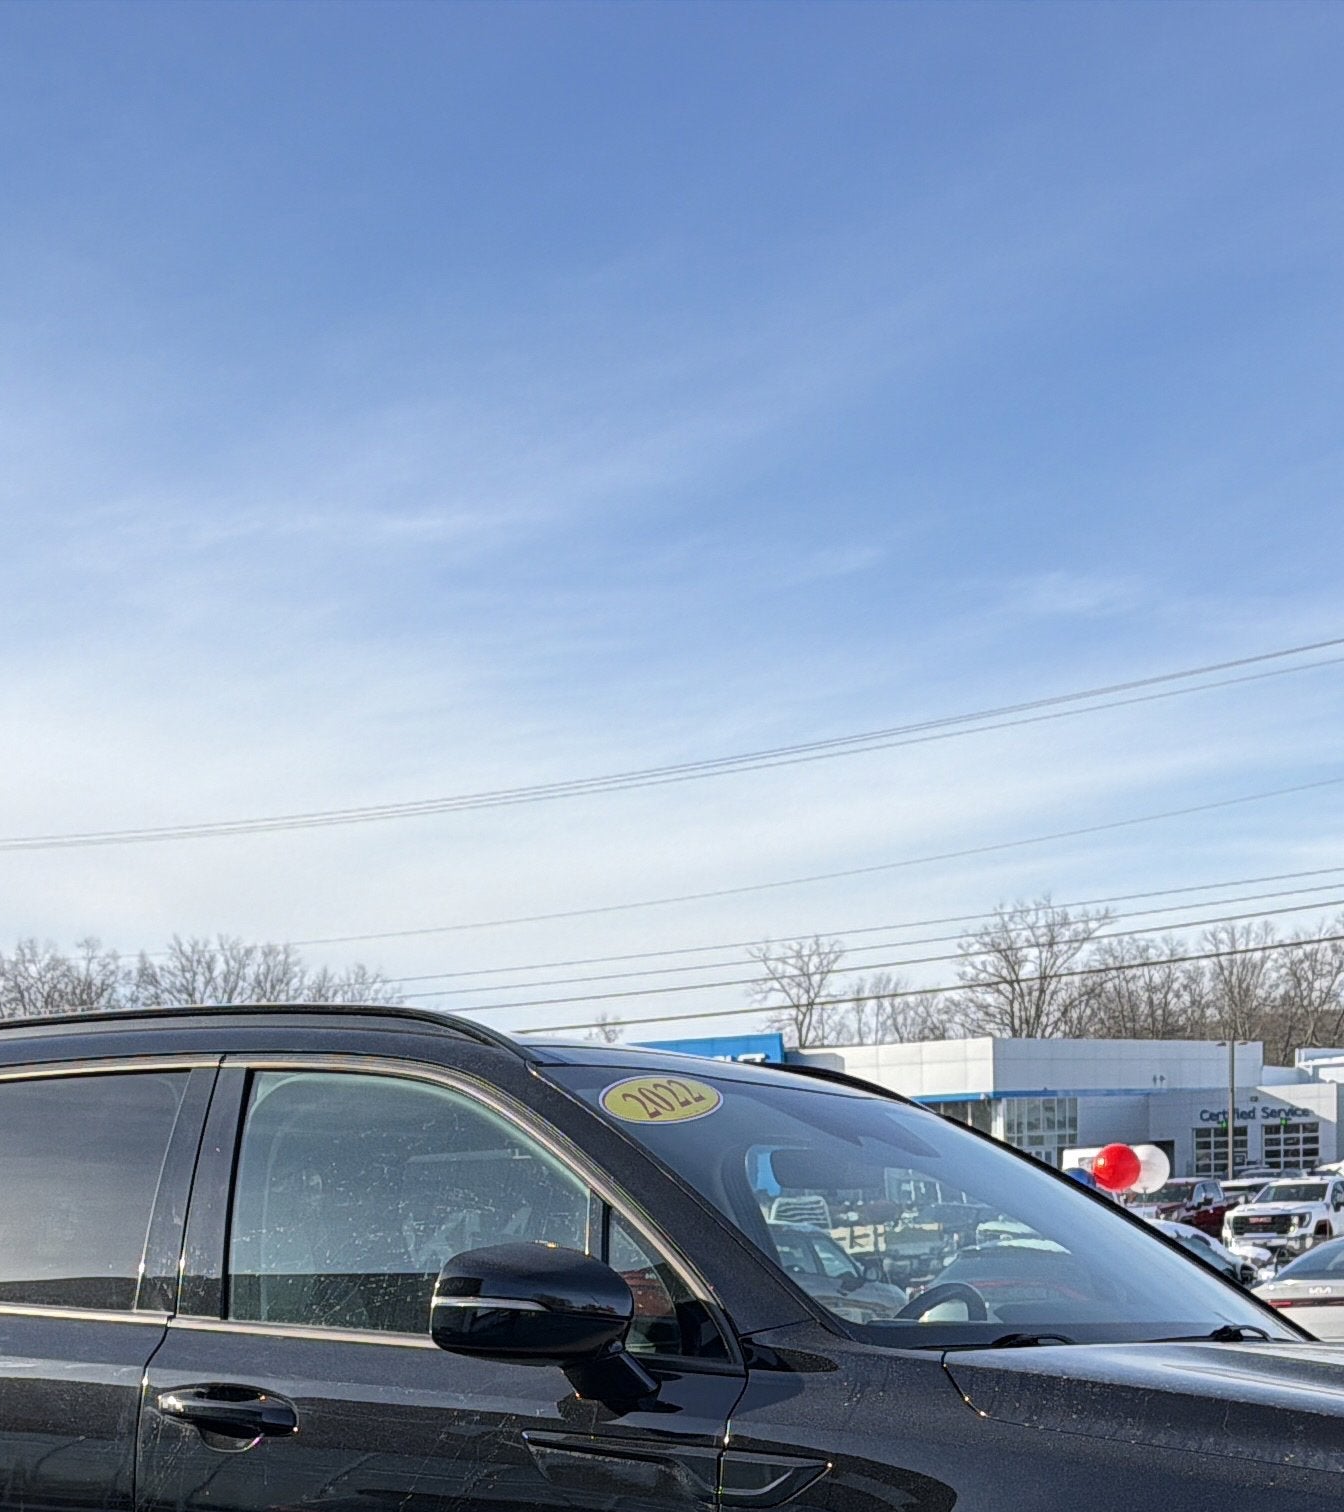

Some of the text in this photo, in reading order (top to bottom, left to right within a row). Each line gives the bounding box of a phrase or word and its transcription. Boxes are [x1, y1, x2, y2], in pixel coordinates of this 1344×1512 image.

[621, 1079, 706, 1119] 2022
[1261, 1106, 1312, 1119] Service
[1309, 1286, 1332, 1295] KIA
